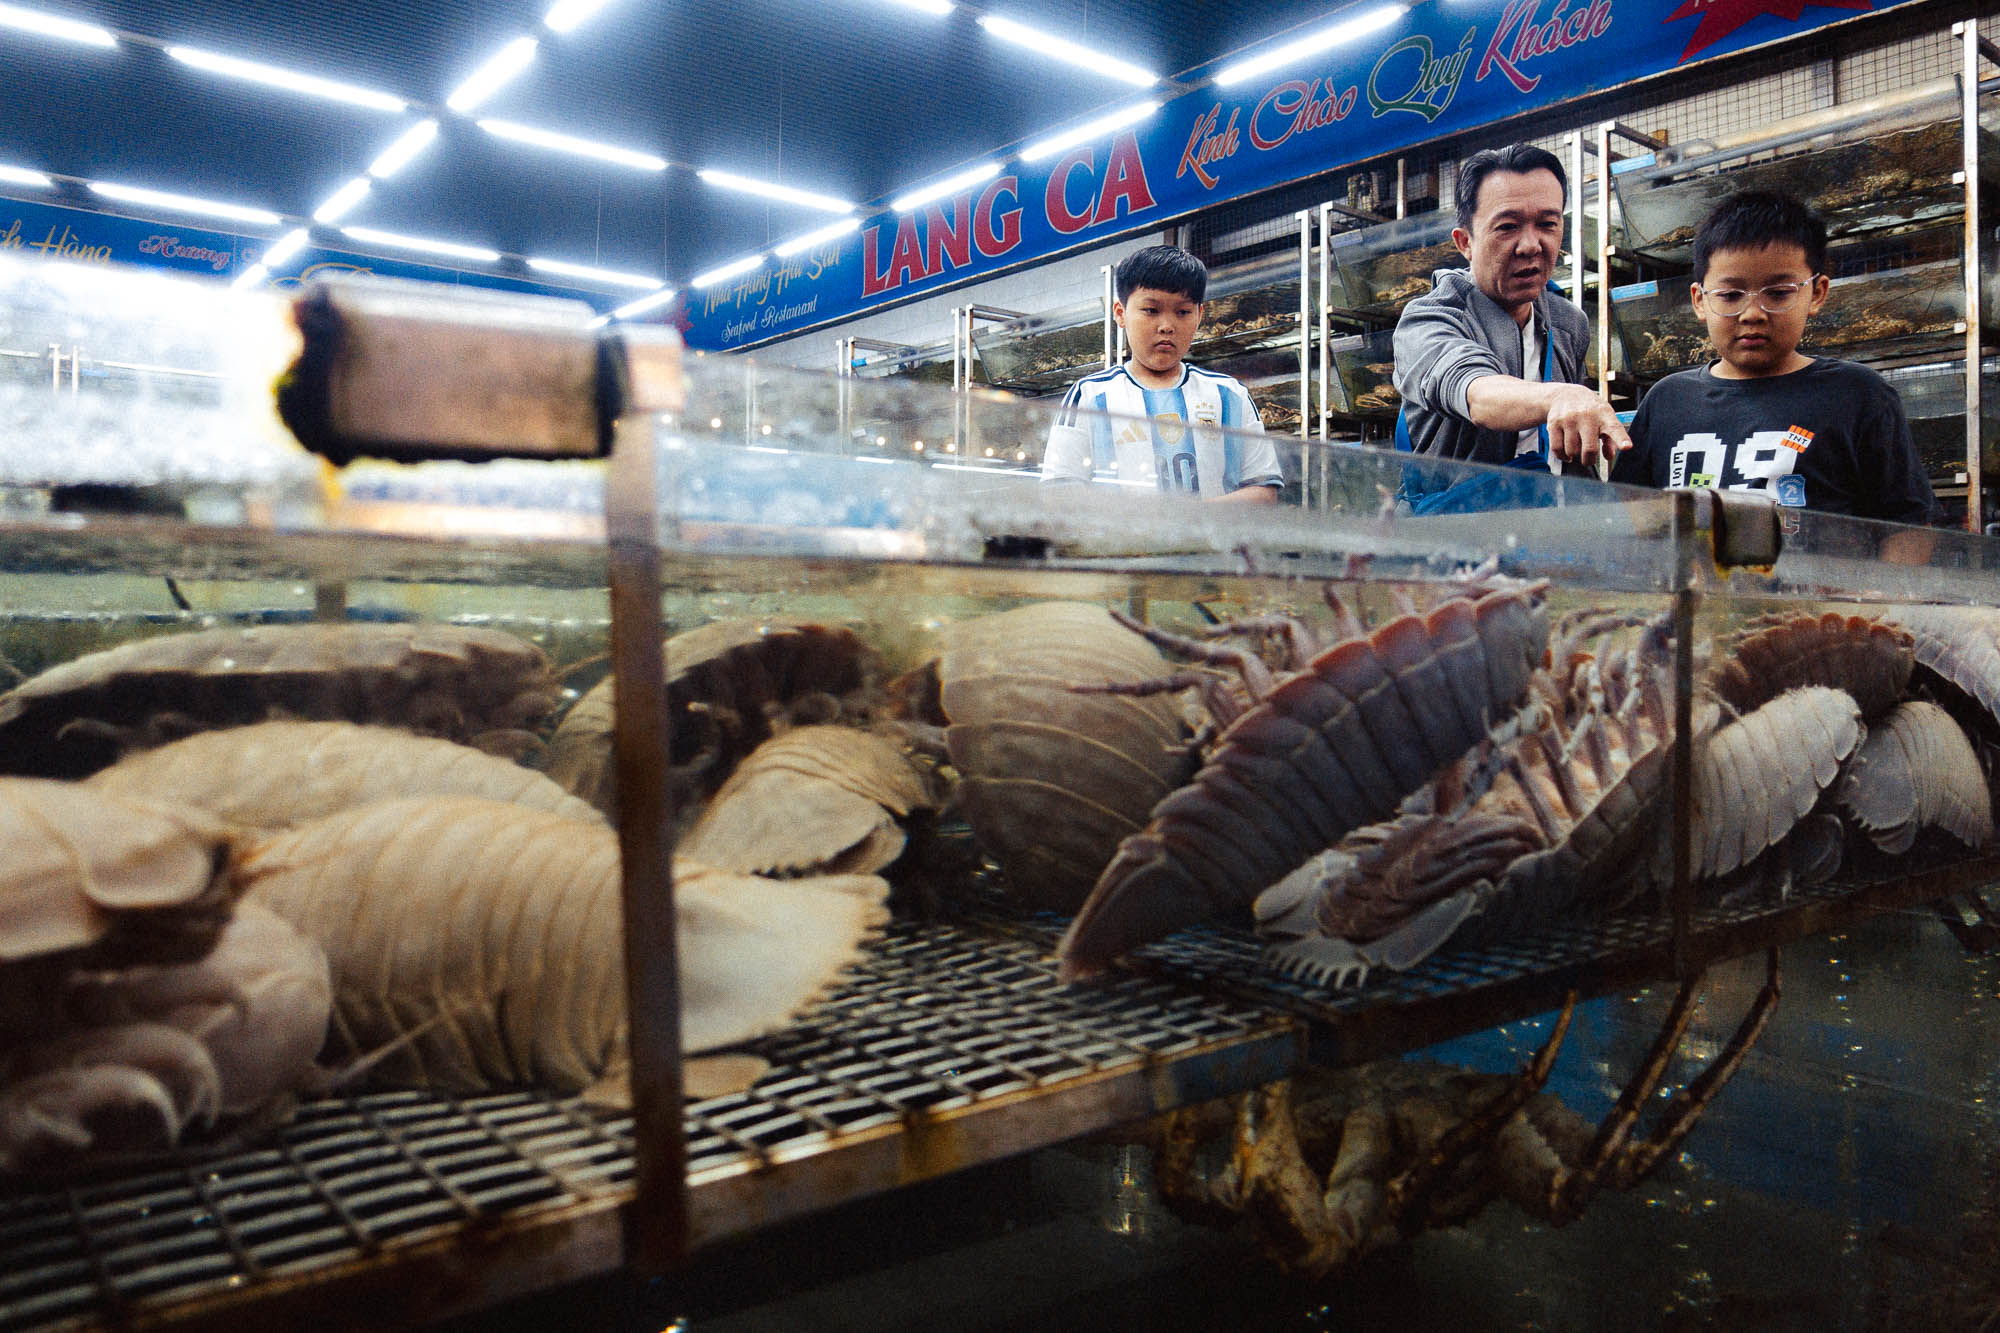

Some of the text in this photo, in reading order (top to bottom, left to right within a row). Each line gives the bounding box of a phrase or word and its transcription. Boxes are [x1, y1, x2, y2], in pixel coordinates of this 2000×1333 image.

[1176, 0, 1613, 190] Kính Chào Quý Khách
[720, 293, 818, 343] Seafood Restaurant
[1788, 432, 1808, 445] TNT
